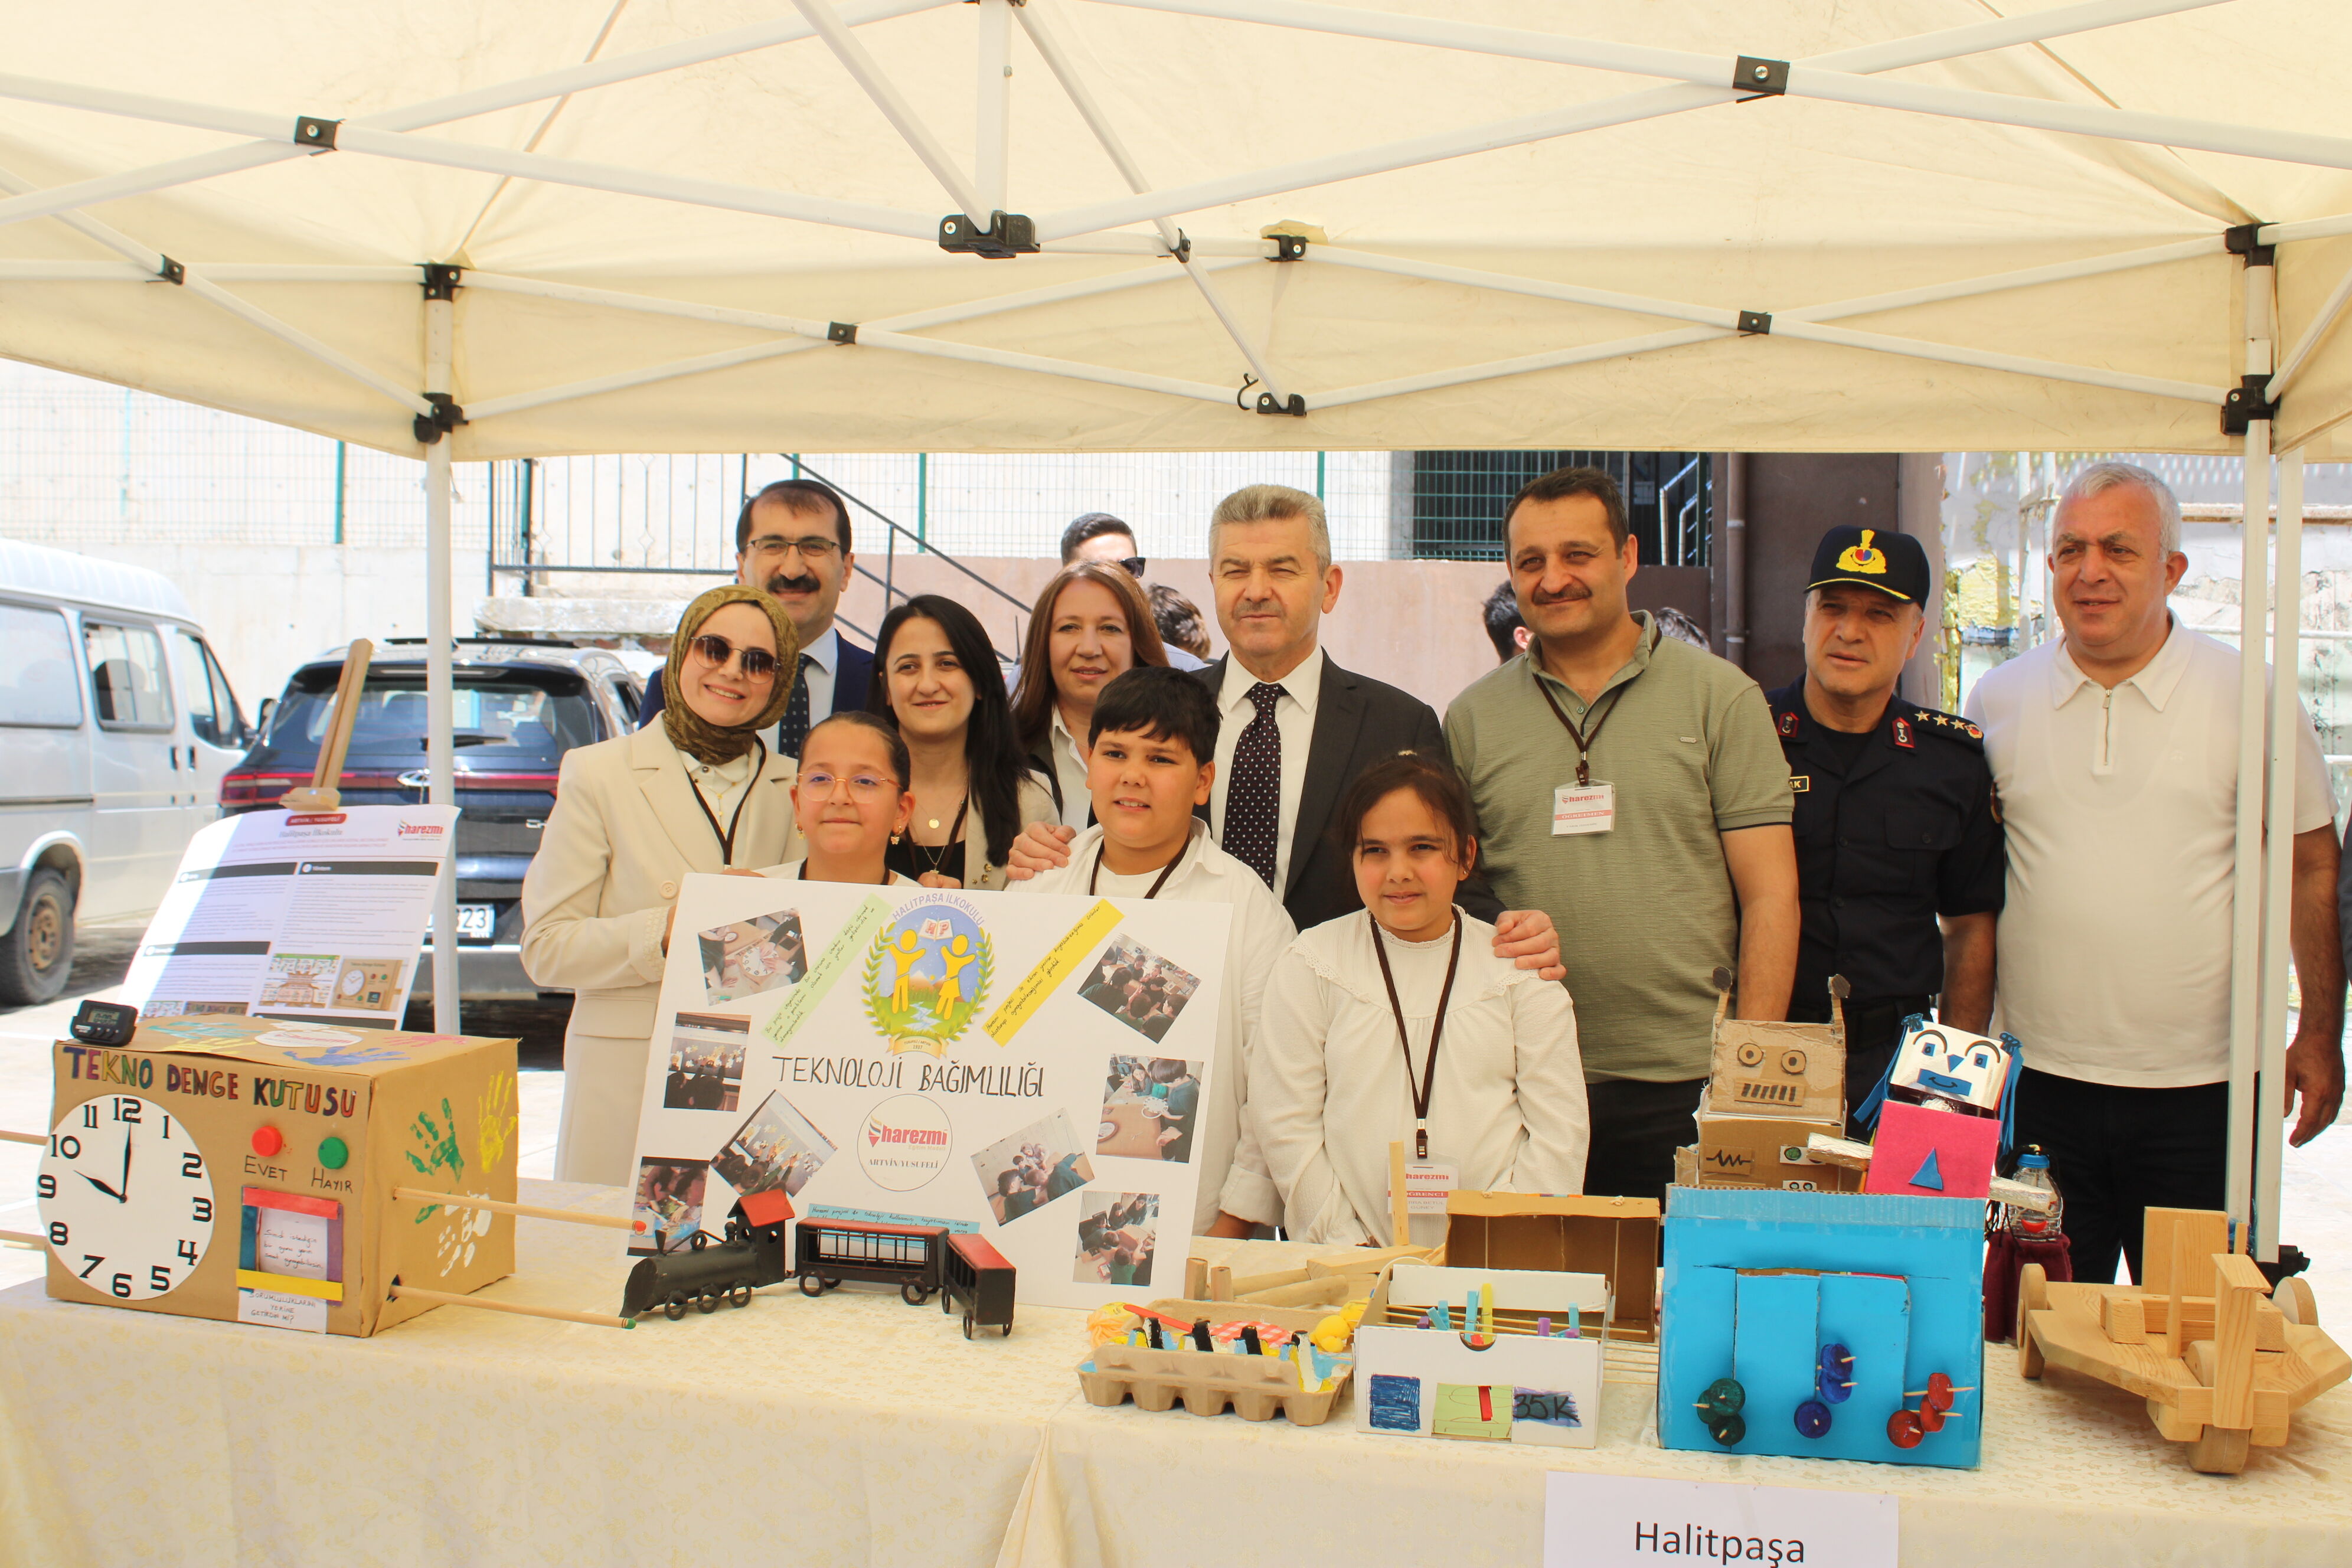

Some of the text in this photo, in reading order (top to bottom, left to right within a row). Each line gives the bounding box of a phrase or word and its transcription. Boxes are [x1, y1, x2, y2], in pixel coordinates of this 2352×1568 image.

[405, 824, 444, 834] harezmi
[892, 893, 985, 926] HALİTPAŞA İLKOKULU
[63, 1046, 357, 1118] TEKNO DENGE KUTUSU
[772, 1056, 1044, 1097] TEKNOLOJİ BAĞIMLILIĞI
[83, 1104, 99, 1129] 11
[113, 1097, 142, 1123] 12
[162, 1115, 170, 1139] 1
[881, 1124, 948, 1145] harezmi
[50, 1134, 81, 1159] 10
[182, 1152, 202, 1178] 2
[244, 1155, 288, 1181] EVET
[37, 1174, 57, 1199] 9
[311, 1167, 353, 1194] HAYIR
[192, 1197, 213, 1223] 3
[50, 1221, 69, 1246] 8
[177, 1239, 198, 1266] 4
[79, 1255, 106, 1279] 7
[150, 1265, 171, 1291] 5
[112, 1273, 132, 1298] 6
[1636, 1521, 1804, 1568] Halitpaşa
